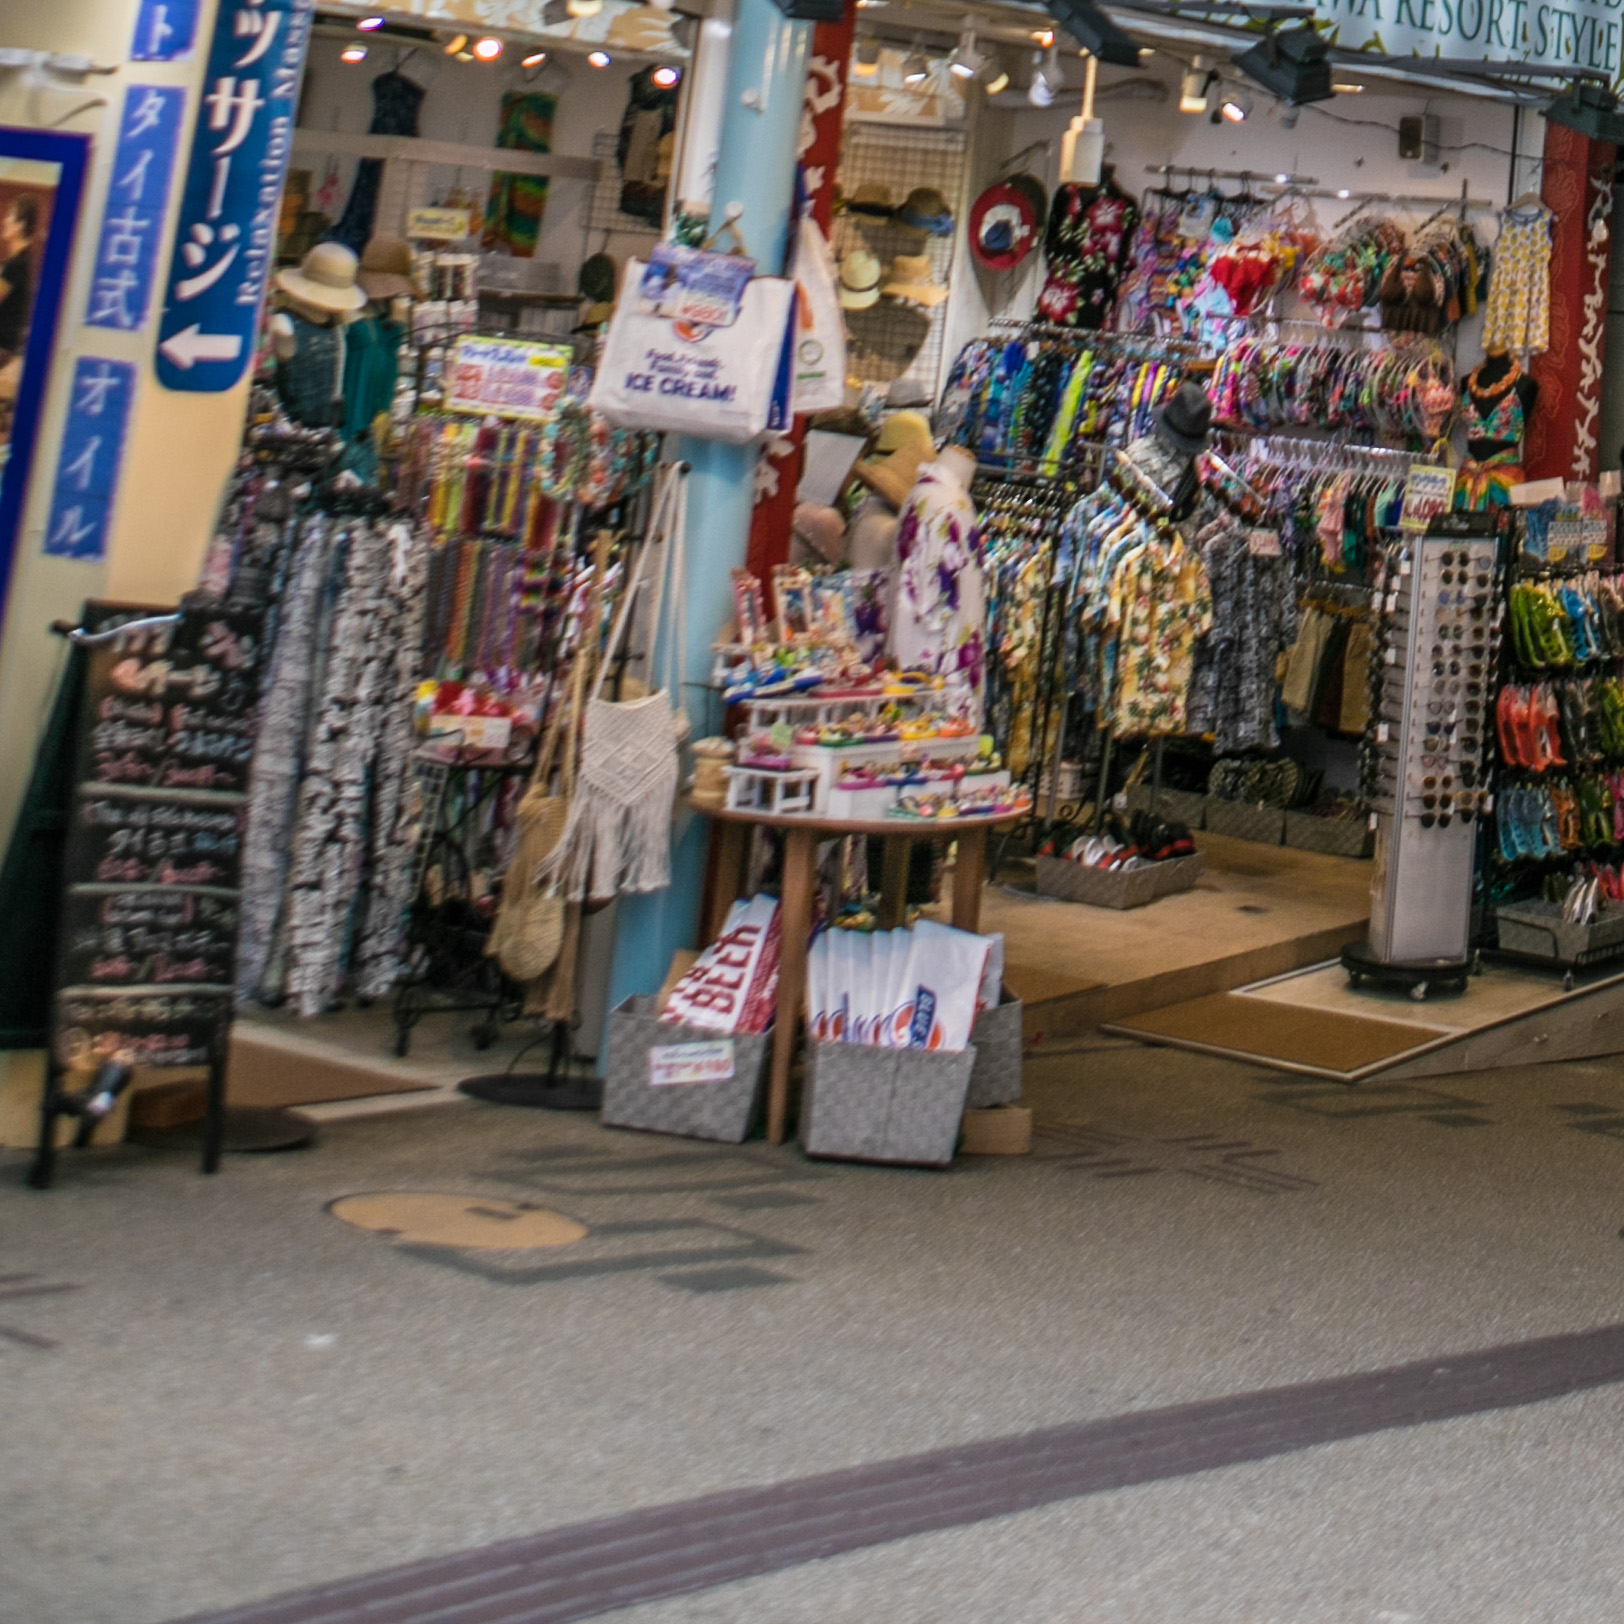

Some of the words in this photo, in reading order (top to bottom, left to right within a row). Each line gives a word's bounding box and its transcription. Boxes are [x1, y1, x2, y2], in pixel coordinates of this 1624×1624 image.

[1537, 4, 1621, 74] STYLE
[86, 88, 167, 329] タイ古式
[625, 371, 655, 392] ICE
[658, 376, 738, 402] CREAM!
[52, 365, 121, 545] オイル
